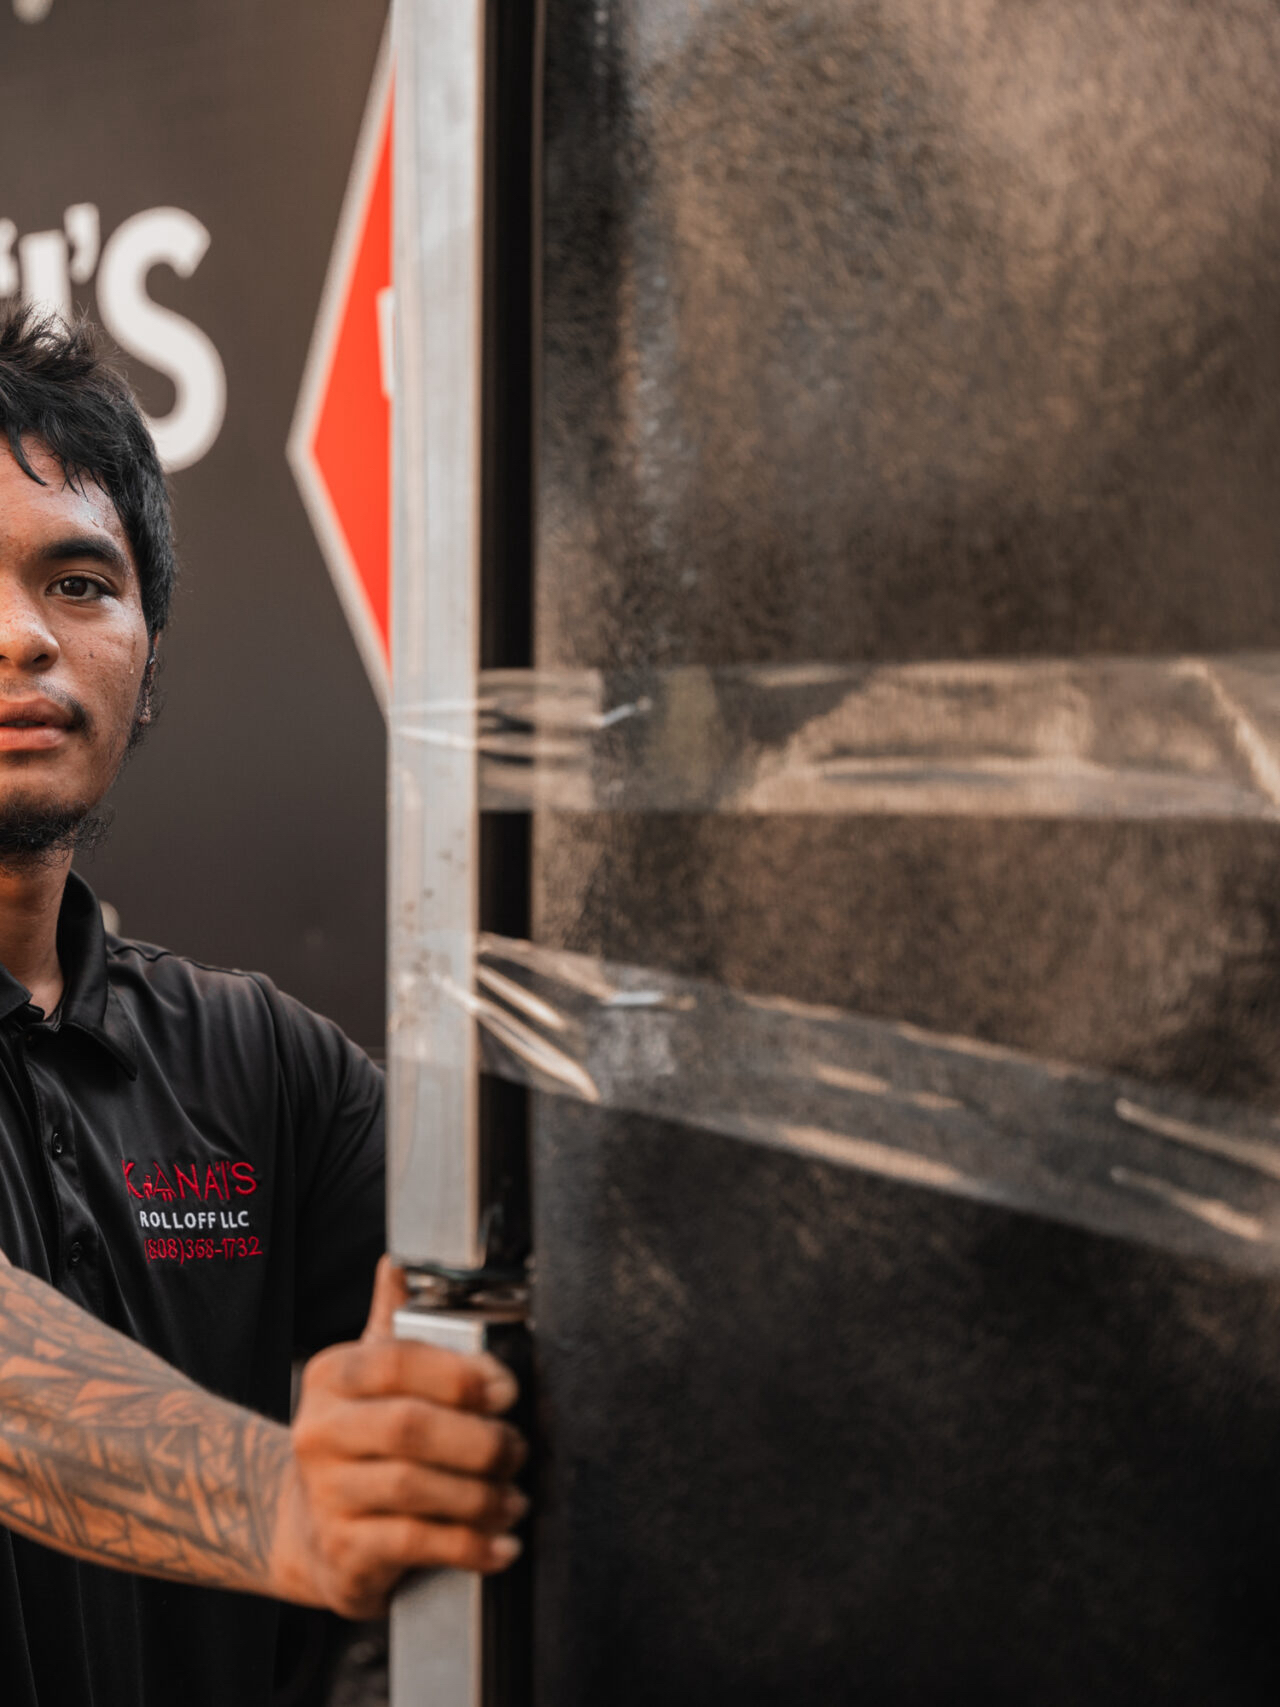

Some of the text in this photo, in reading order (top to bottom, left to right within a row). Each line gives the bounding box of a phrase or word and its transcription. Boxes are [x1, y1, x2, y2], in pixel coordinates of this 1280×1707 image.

[140, 1211, 250, 1229] ROLLOFF LLC
[144, 1236, 263, 1265] (808)368-1732
